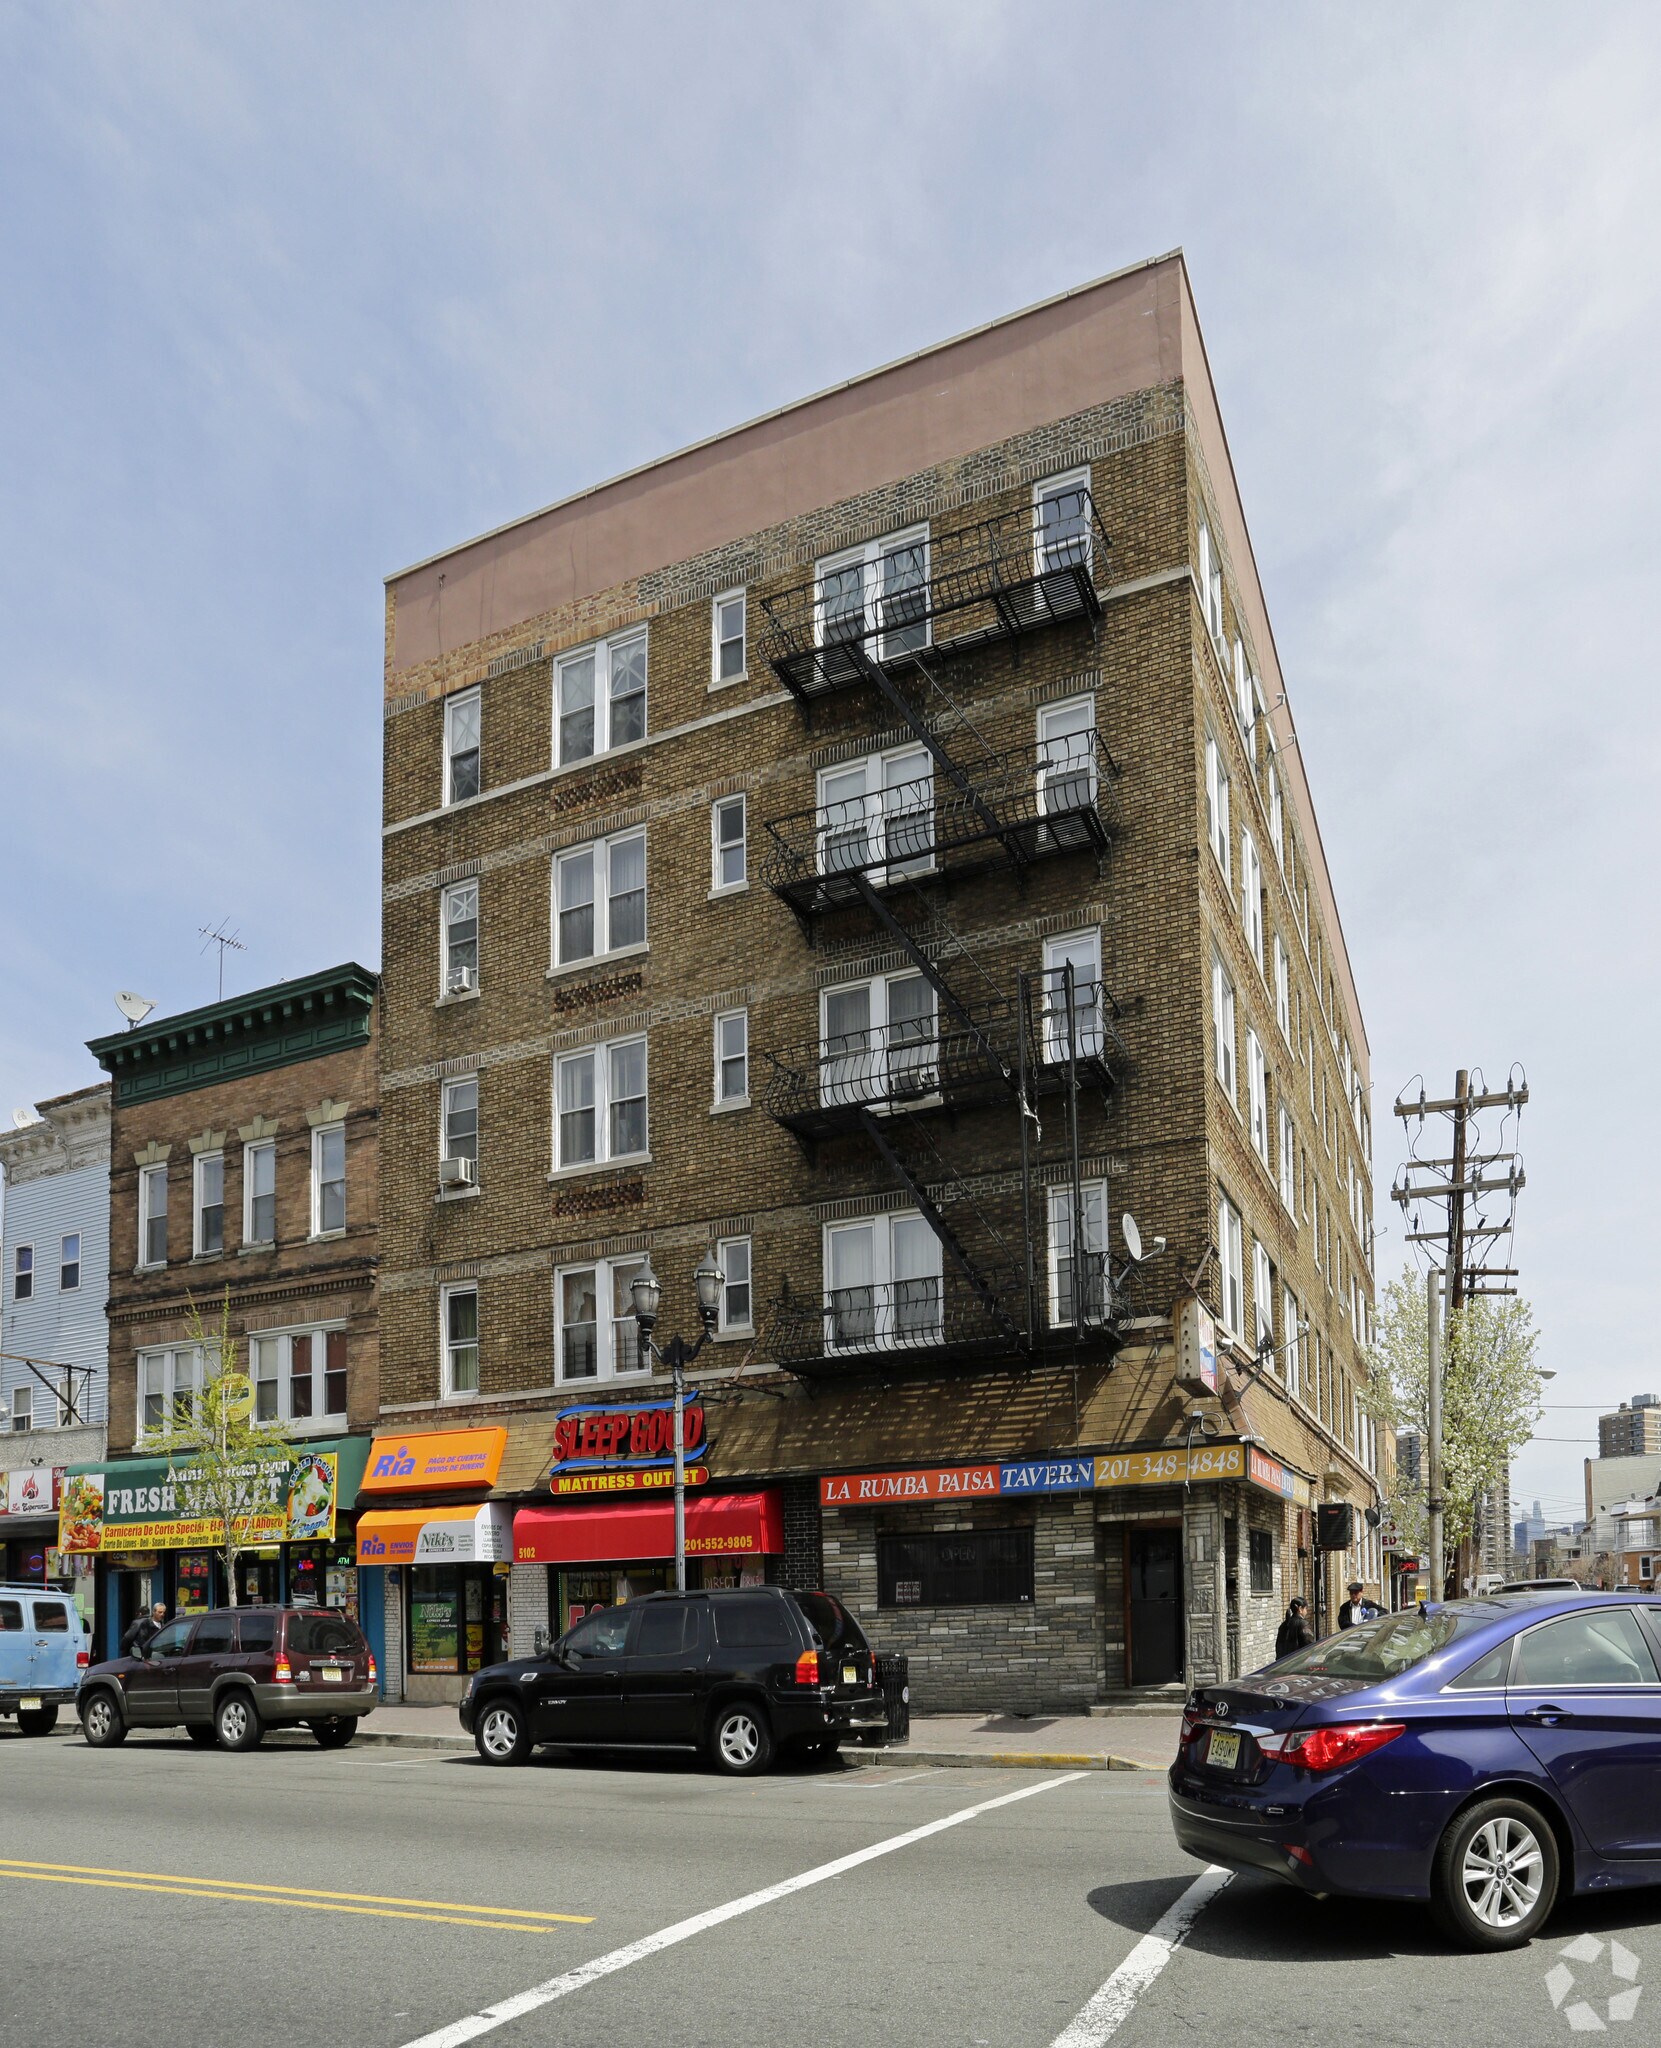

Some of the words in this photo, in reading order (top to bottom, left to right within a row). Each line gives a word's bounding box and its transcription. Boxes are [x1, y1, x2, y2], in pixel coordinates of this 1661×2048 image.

[553, 1413, 630, 1460] SLEEP
[372, 1446, 416, 1477] Ria
[428, 1457, 446, 1465] PAGO
[457, 1453, 487, 1462] CUENTAS
[313, 1457, 334, 1484] YOGURT
[825, 1481, 850, 1500] LA
[859, 1475, 928, 1498] RUMBA
[937, 1470, 995, 1493] PAISA
[1001, 1462, 1093, 1488] TAVERN
[1098, 1449, 1239, 1481] 201-348-4848
[558, 1474, 635, 1492] MATTRESS
[107, 1486, 176, 1515] FRESH
[104, 1527, 142, 1538] Carniceria
[143, 1524, 153, 1536] De
[154, 1522, 175, 1535] Corte
[360, 1534, 386, 1555] Ria
[390, 1541, 414, 1549] ENVIOS
[421, 1532, 454, 1548] Niki's
[518, 1547, 535, 1559] 5102
[684, 1535, 753, 1551] 201-552-9805
[337, 1556, 350, 1565] ATM
[703, 1576, 737, 1590] DIRECT
[420, 1603, 452, 1618] Niki's
